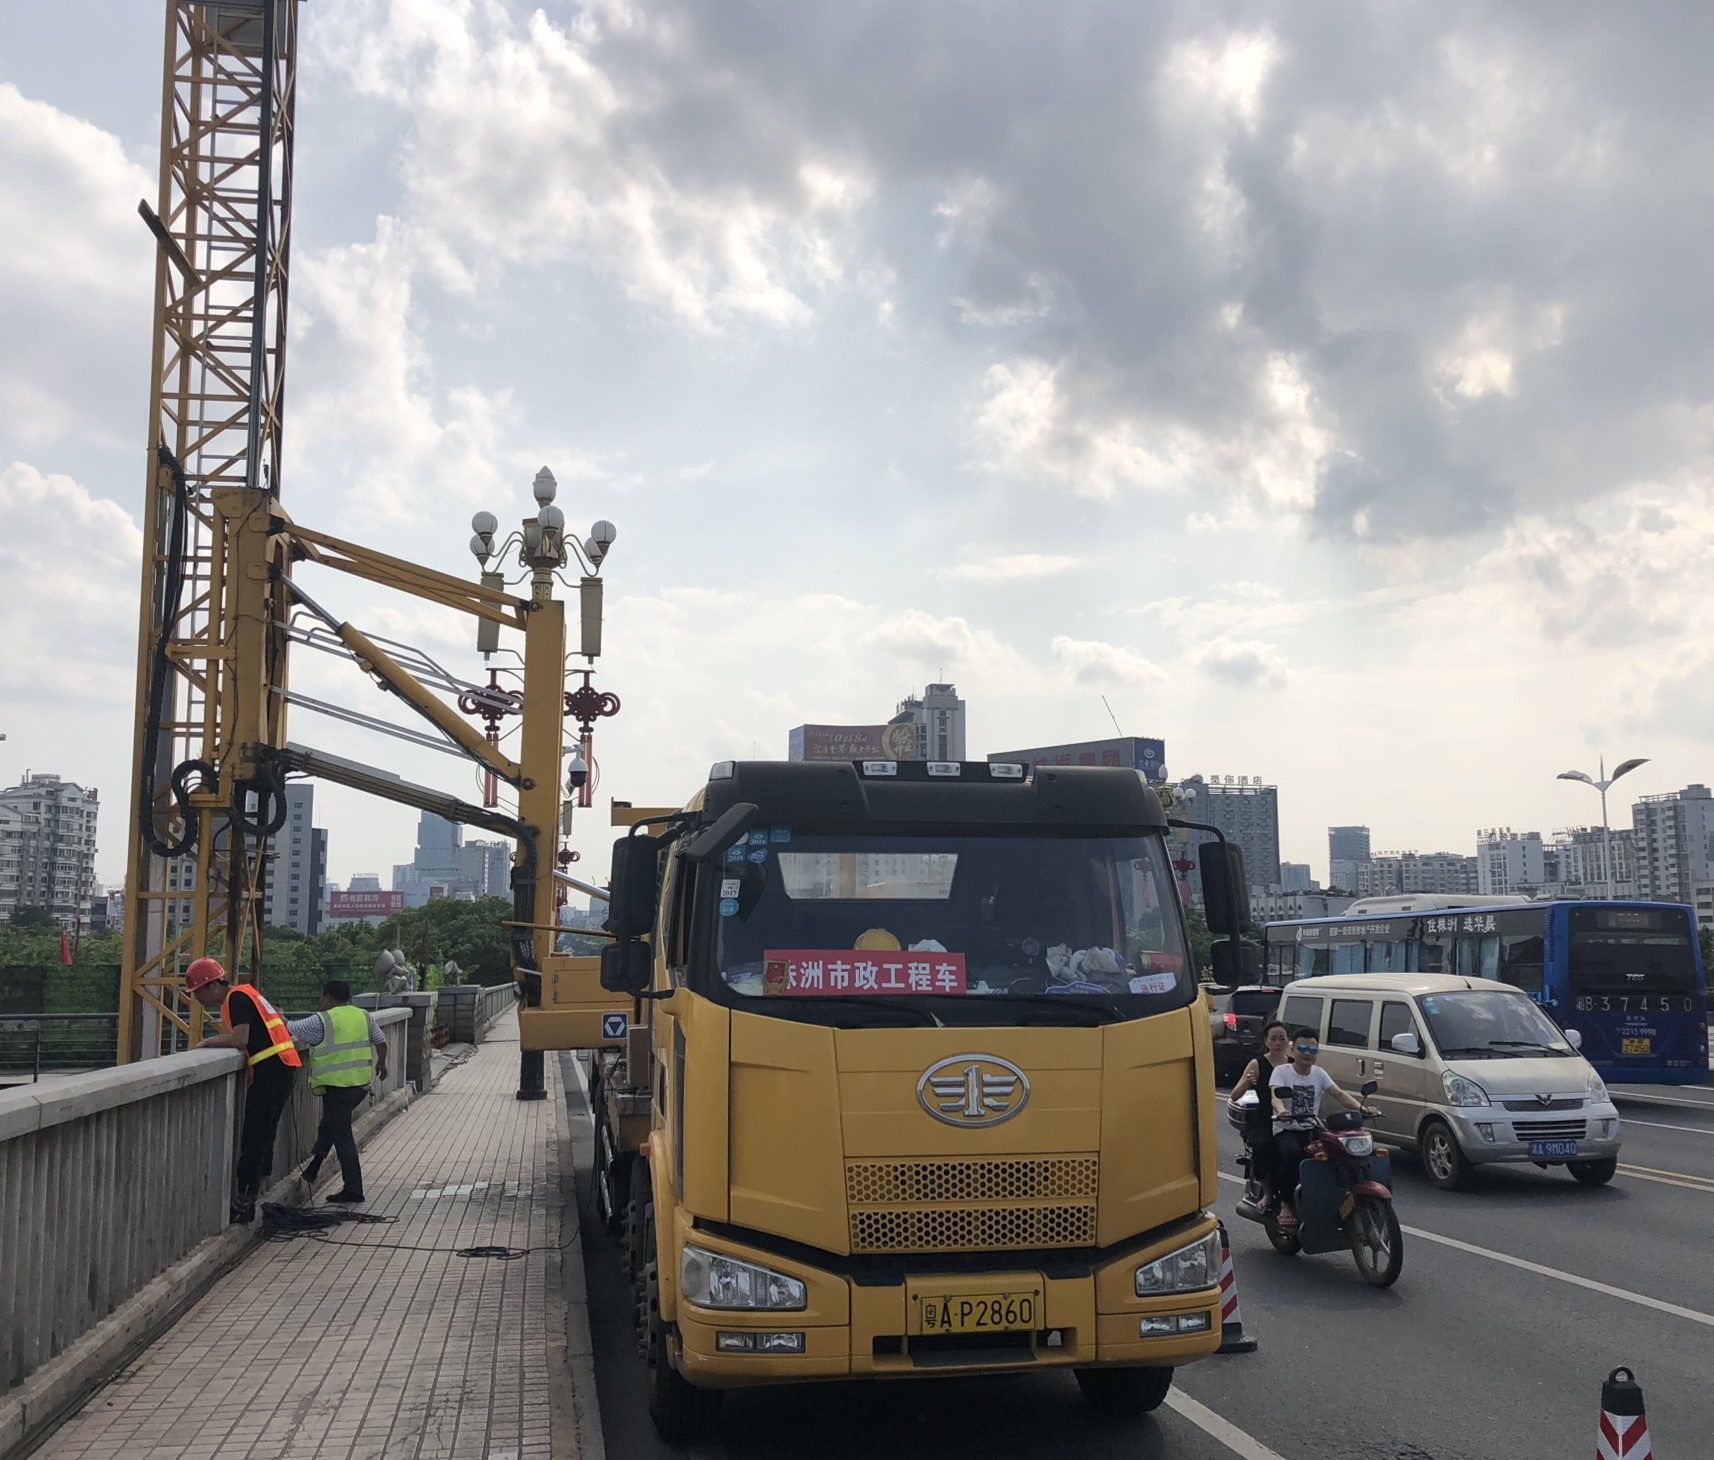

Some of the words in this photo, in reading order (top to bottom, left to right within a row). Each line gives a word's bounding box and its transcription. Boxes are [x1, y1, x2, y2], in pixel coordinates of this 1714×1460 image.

[1427, 917, 1458, 933] 住株洲
[1463, 914, 1496, 933] 选华晨
[1623, 1044, 1649, 1053] 37450
